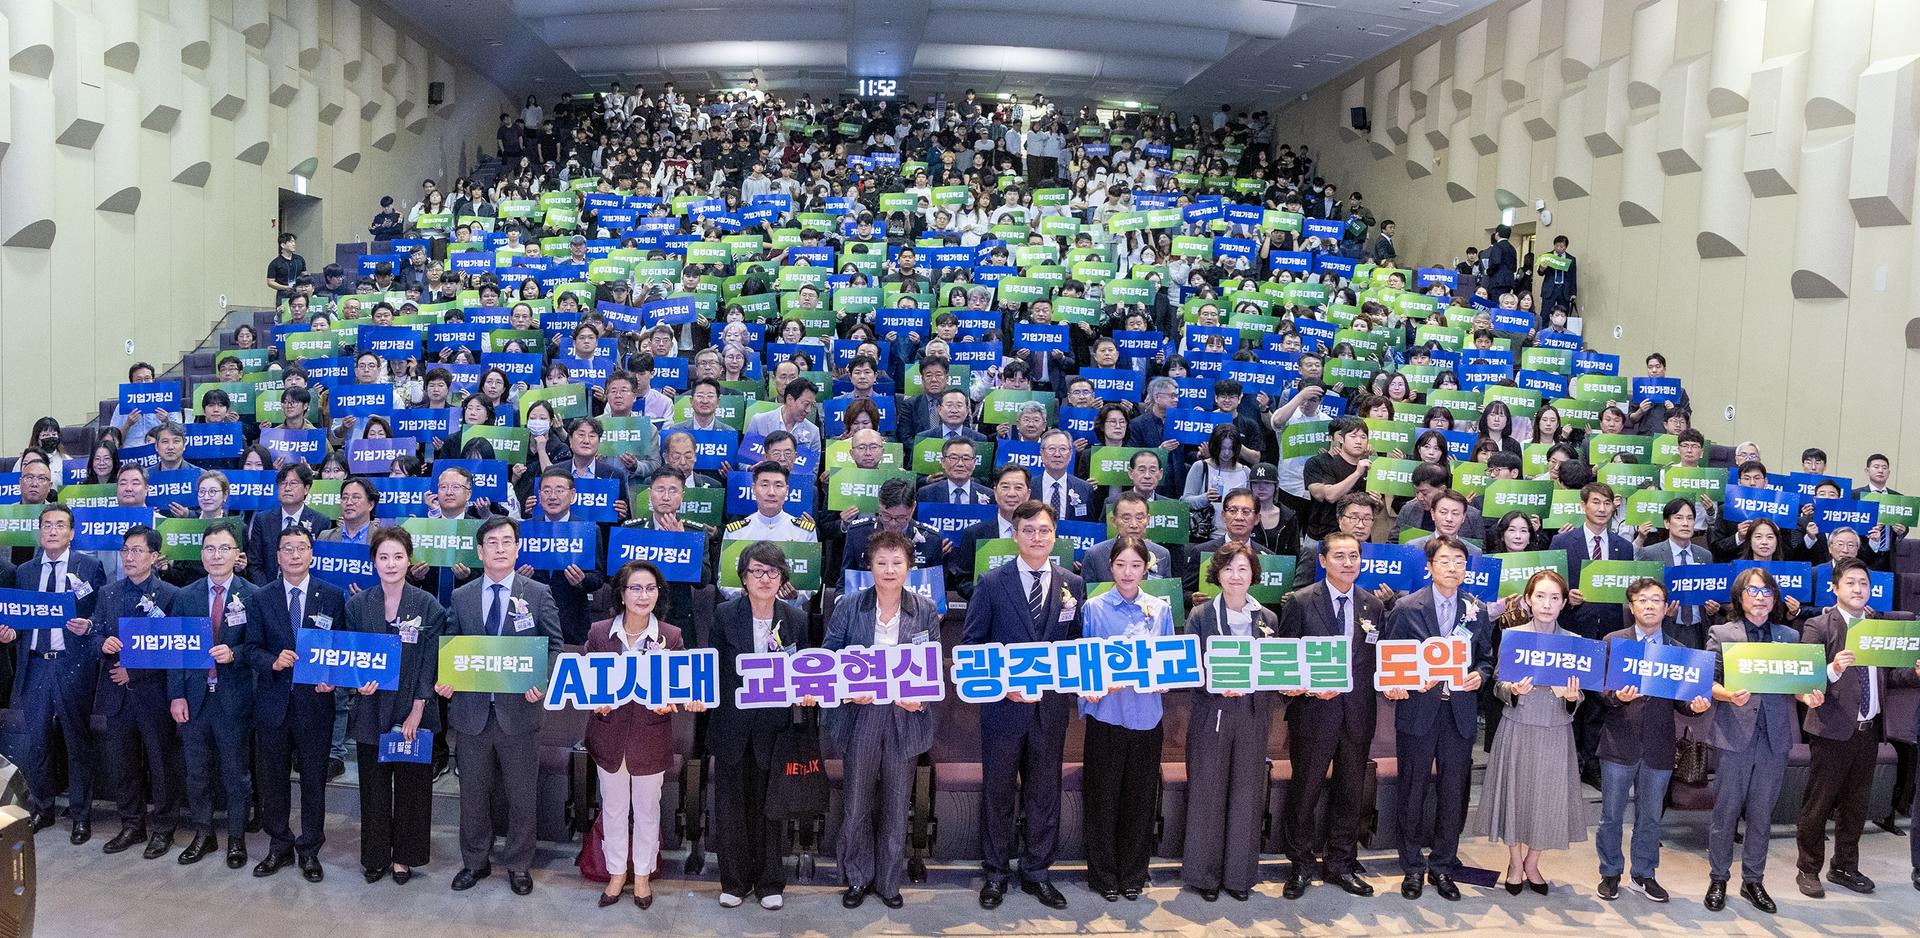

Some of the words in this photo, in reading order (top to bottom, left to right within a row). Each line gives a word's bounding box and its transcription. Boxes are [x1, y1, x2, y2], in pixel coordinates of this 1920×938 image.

[859, 80, 896, 97] 11:52
[1004, 284, 1043, 295] 광주대학교
[1112, 286, 1149, 297] 광주대학교
[603, 309, 638, 322] 기업가정신
[649, 307, 690, 318] 기업가정신
[1057, 305, 1095, 316] 광주대학교
[1300, 327, 1334, 338] 기업가정신
[1545, 338, 1577, 349] 기업가정신
[1575, 360, 1612, 371] 기업가정신
[570, 368, 605, 378] 업가정신
[1228, 371, 1275, 383] 기업가정신
[1330, 367, 1371, 379] 광주대학교
[1525, 379, 1562, 391] 기업가정신
[127, 392, 173, 404] 기업가정신
[337, 394, 385, 406] 기업가정신
[399, 419, 446, 430] 기업가정신
[1174, 420, 1215, 432] 기업가정
[184, 434, 233, 446] 기업가정신
[1672, 478, 1720, 489] 광주대학교
[1495, 493, 1546, 506] 광주대학교
[1735, 497, 1789, 515] 기업가정신
[1823, 510, 1870, 523] 기업가정신
[519, 537, 582, 552] 기업가정신
[621, 543, 691, 564] 기업가정신
[1672, 577, 1727, 591] 기업가정신
[0, 602, 63, 616] 기업가정신
[131, 635, 200, 650] 기업가정신
[1858, 636, 1919, 651] 광주대학교
[310, 649, 387, 669] 기업가정신
[453, 655, 533, 672] 광주대학교
[1515, 648, 1592, 672] 기업가정신
[549, 653, 716, 704] AI시대
[740, 646, 942, 704] 교육혁신
[958, 639, 1200, 699] 광주대학교
[1211, 640, 1349, 689] 글로벌
[1379, 641, 1467, 687] 도약
[1622, 658, 1700, 683] 기업가정신
[1738, 658, 1814, 676] 광주대학교
